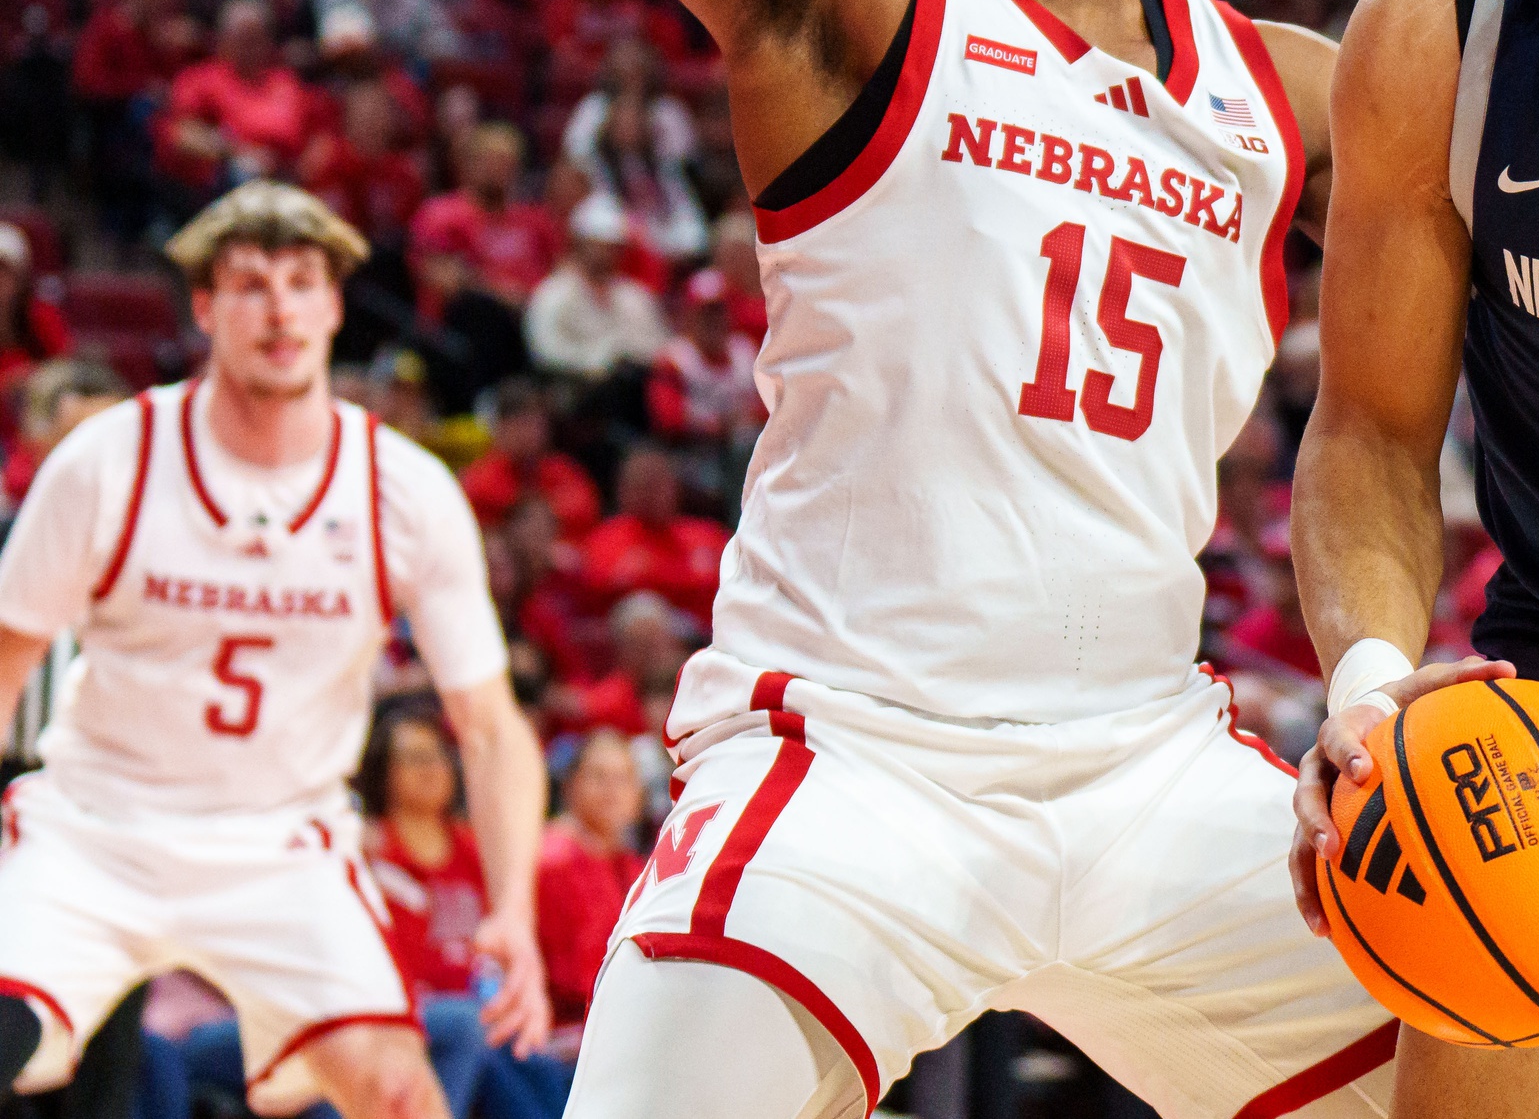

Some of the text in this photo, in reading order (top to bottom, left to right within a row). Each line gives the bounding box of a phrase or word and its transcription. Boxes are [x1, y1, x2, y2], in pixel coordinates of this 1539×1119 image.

[968, 43, 1035, 68] GRADUATE
[942, 113, 1243, 244] NEBRASKA
[1018, 221, 1188, 443] 15
[144, 572, 351, 619] NEBRASKA
[205, 636, 275, 738] 5
[1485, 734, 1503, 760] BALL
[1441, 743, 1518, 863] PRO
[1495, 759, 1518, 792] GAME
[1511, 792, 1539, 847] OFFICIAL
